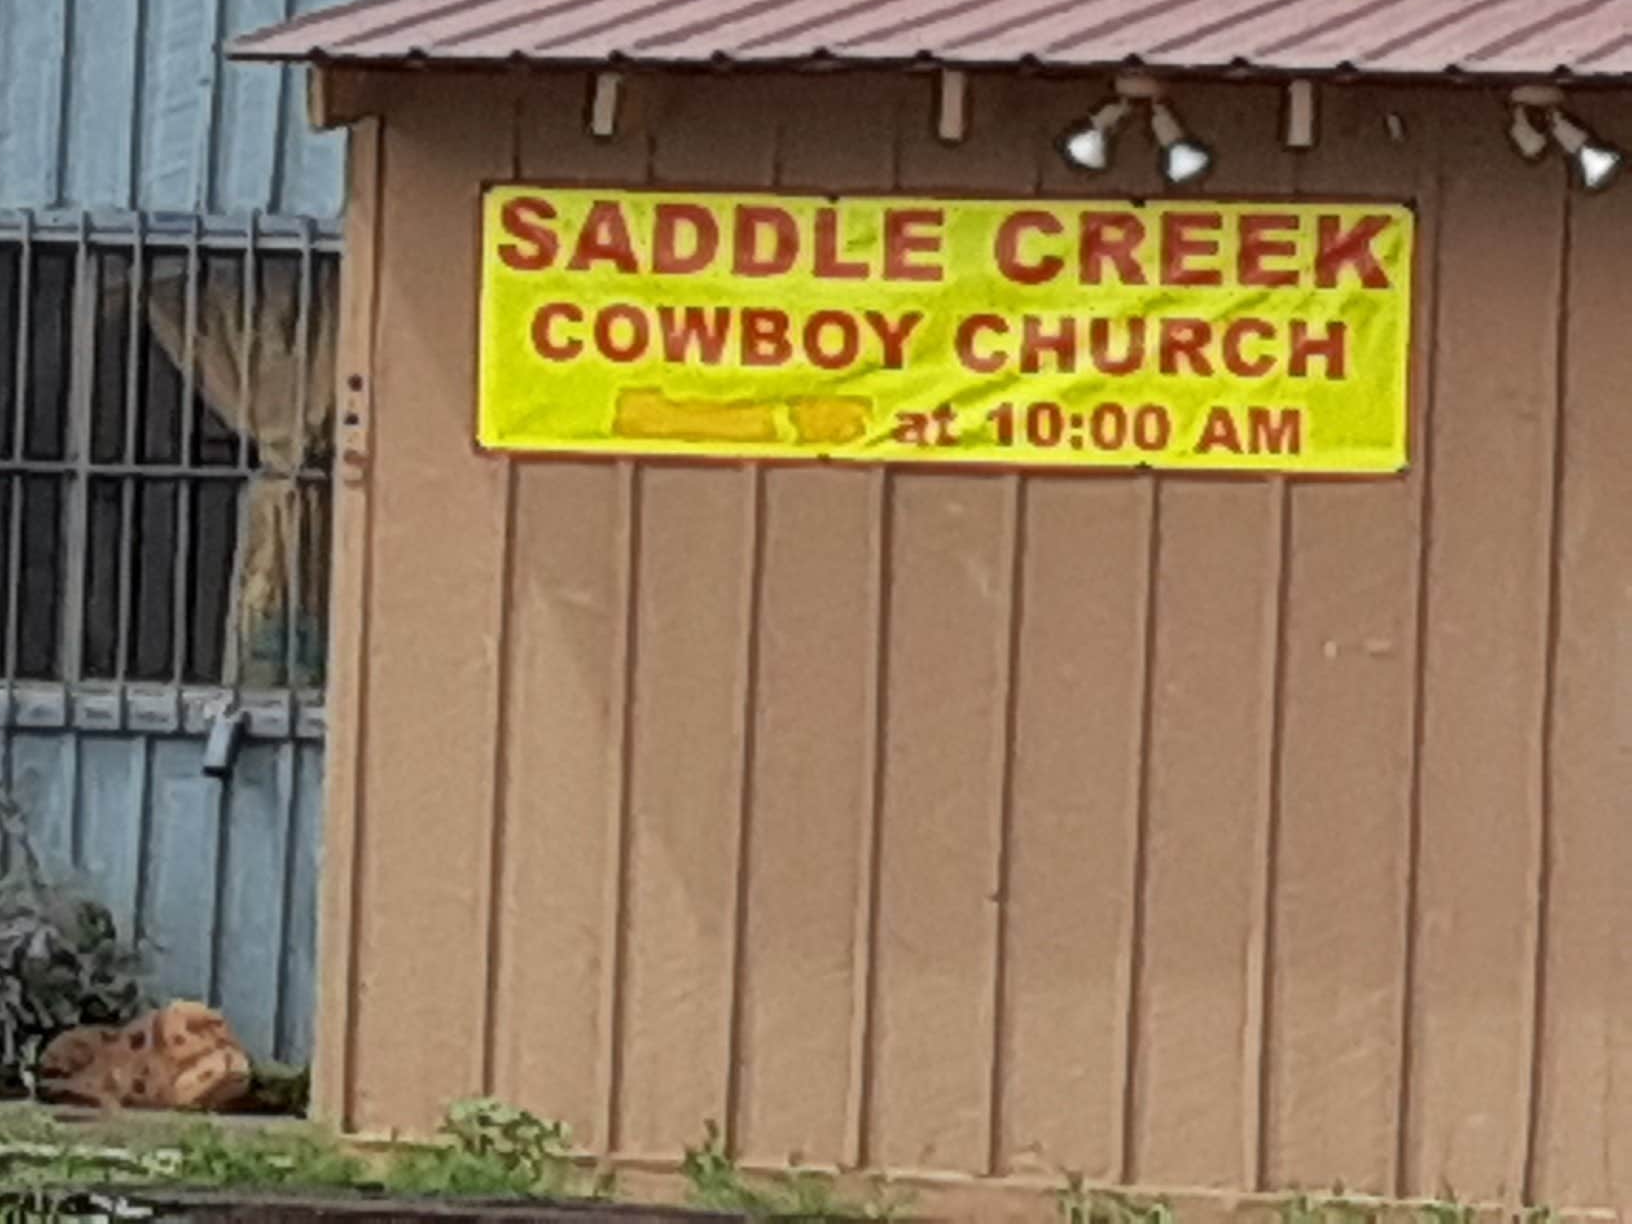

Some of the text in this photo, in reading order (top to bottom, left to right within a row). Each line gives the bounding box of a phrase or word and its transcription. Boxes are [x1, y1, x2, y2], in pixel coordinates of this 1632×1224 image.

[496, 194, 1399, 291] SADDLE CREEK
[530, 301, 1349, 381] COWBOY CHURCH
[888, 401, 1302, 456] at 10:00 AM
